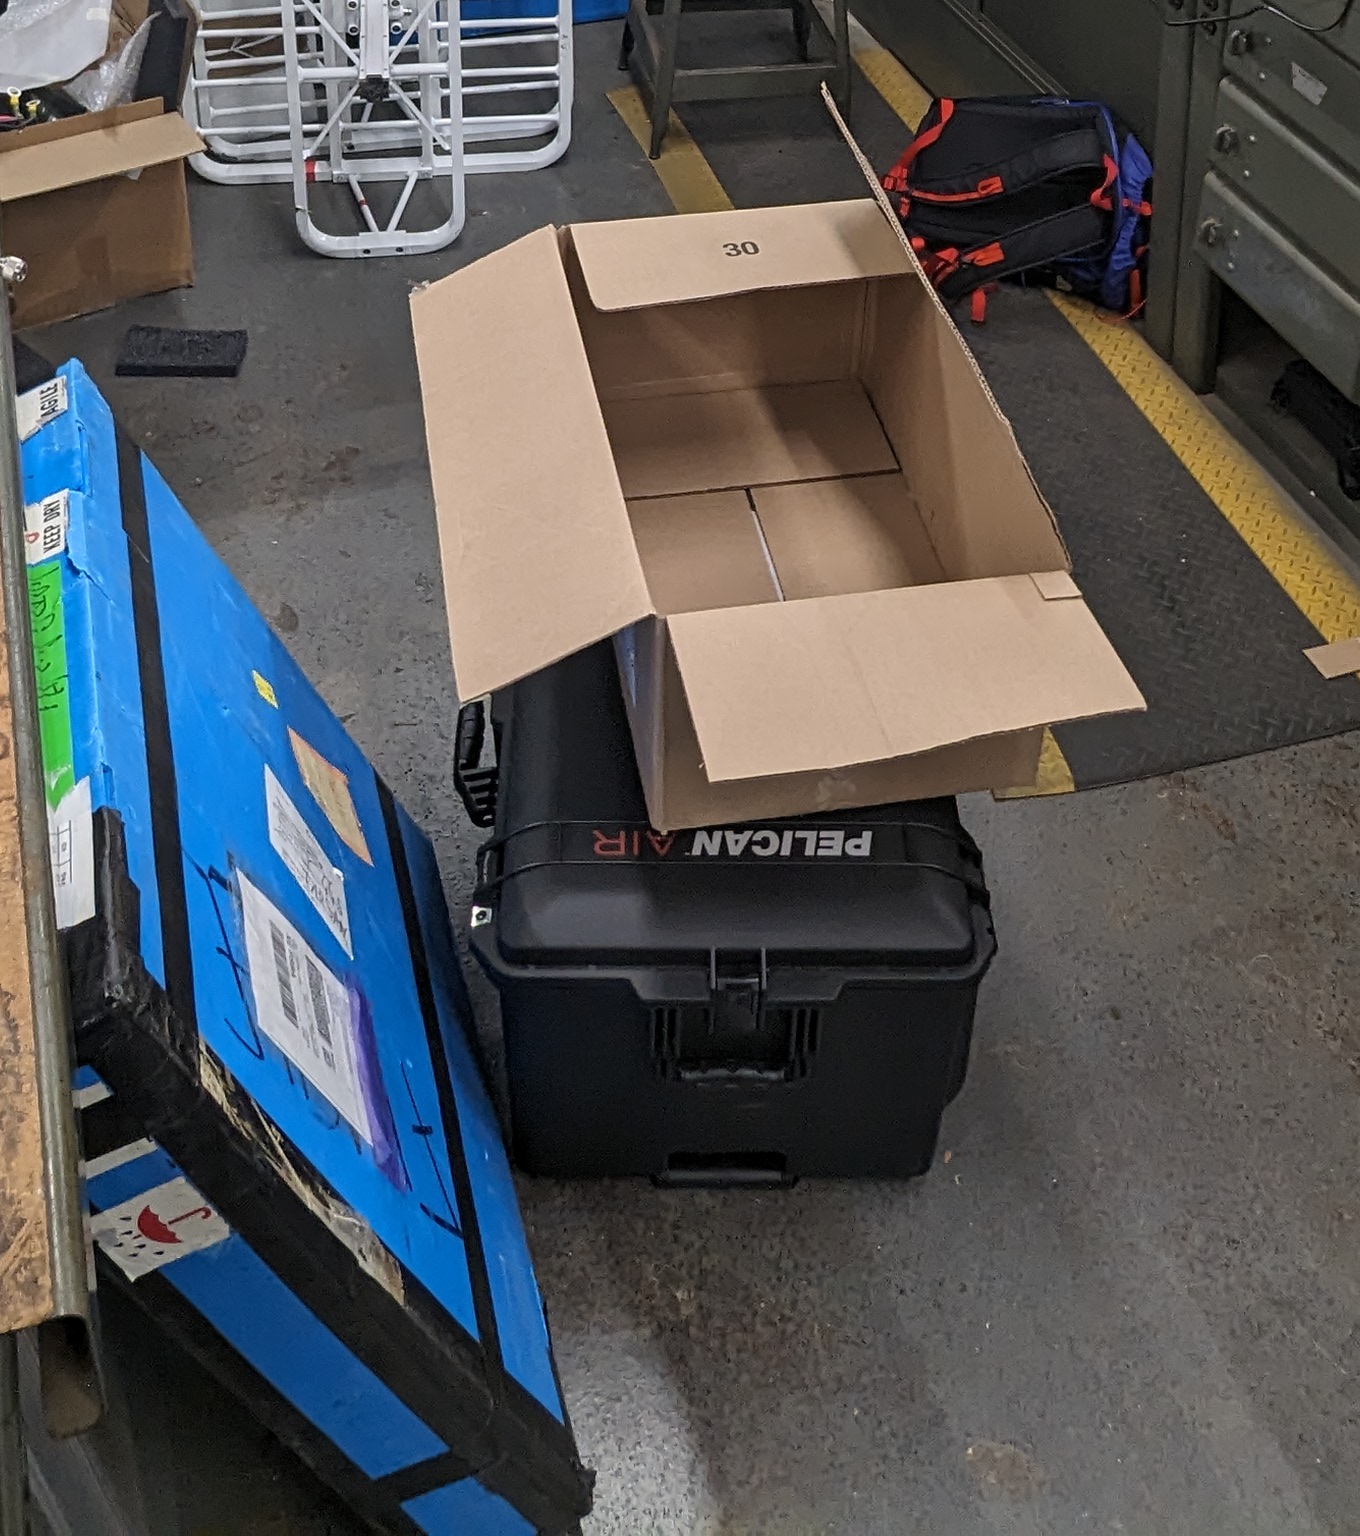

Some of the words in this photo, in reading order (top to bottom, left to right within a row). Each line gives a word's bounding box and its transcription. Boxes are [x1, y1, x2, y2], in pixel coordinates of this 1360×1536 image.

[722, 240, 760, 259] 30
[40, 381, 59, 422] AGILE
[44, 497, 60, 520] DRY
[43, 518, 59, 554] KEEP
[592, 829, 675, 857] AIR
[693, 829, 873, 857] PELICAN
